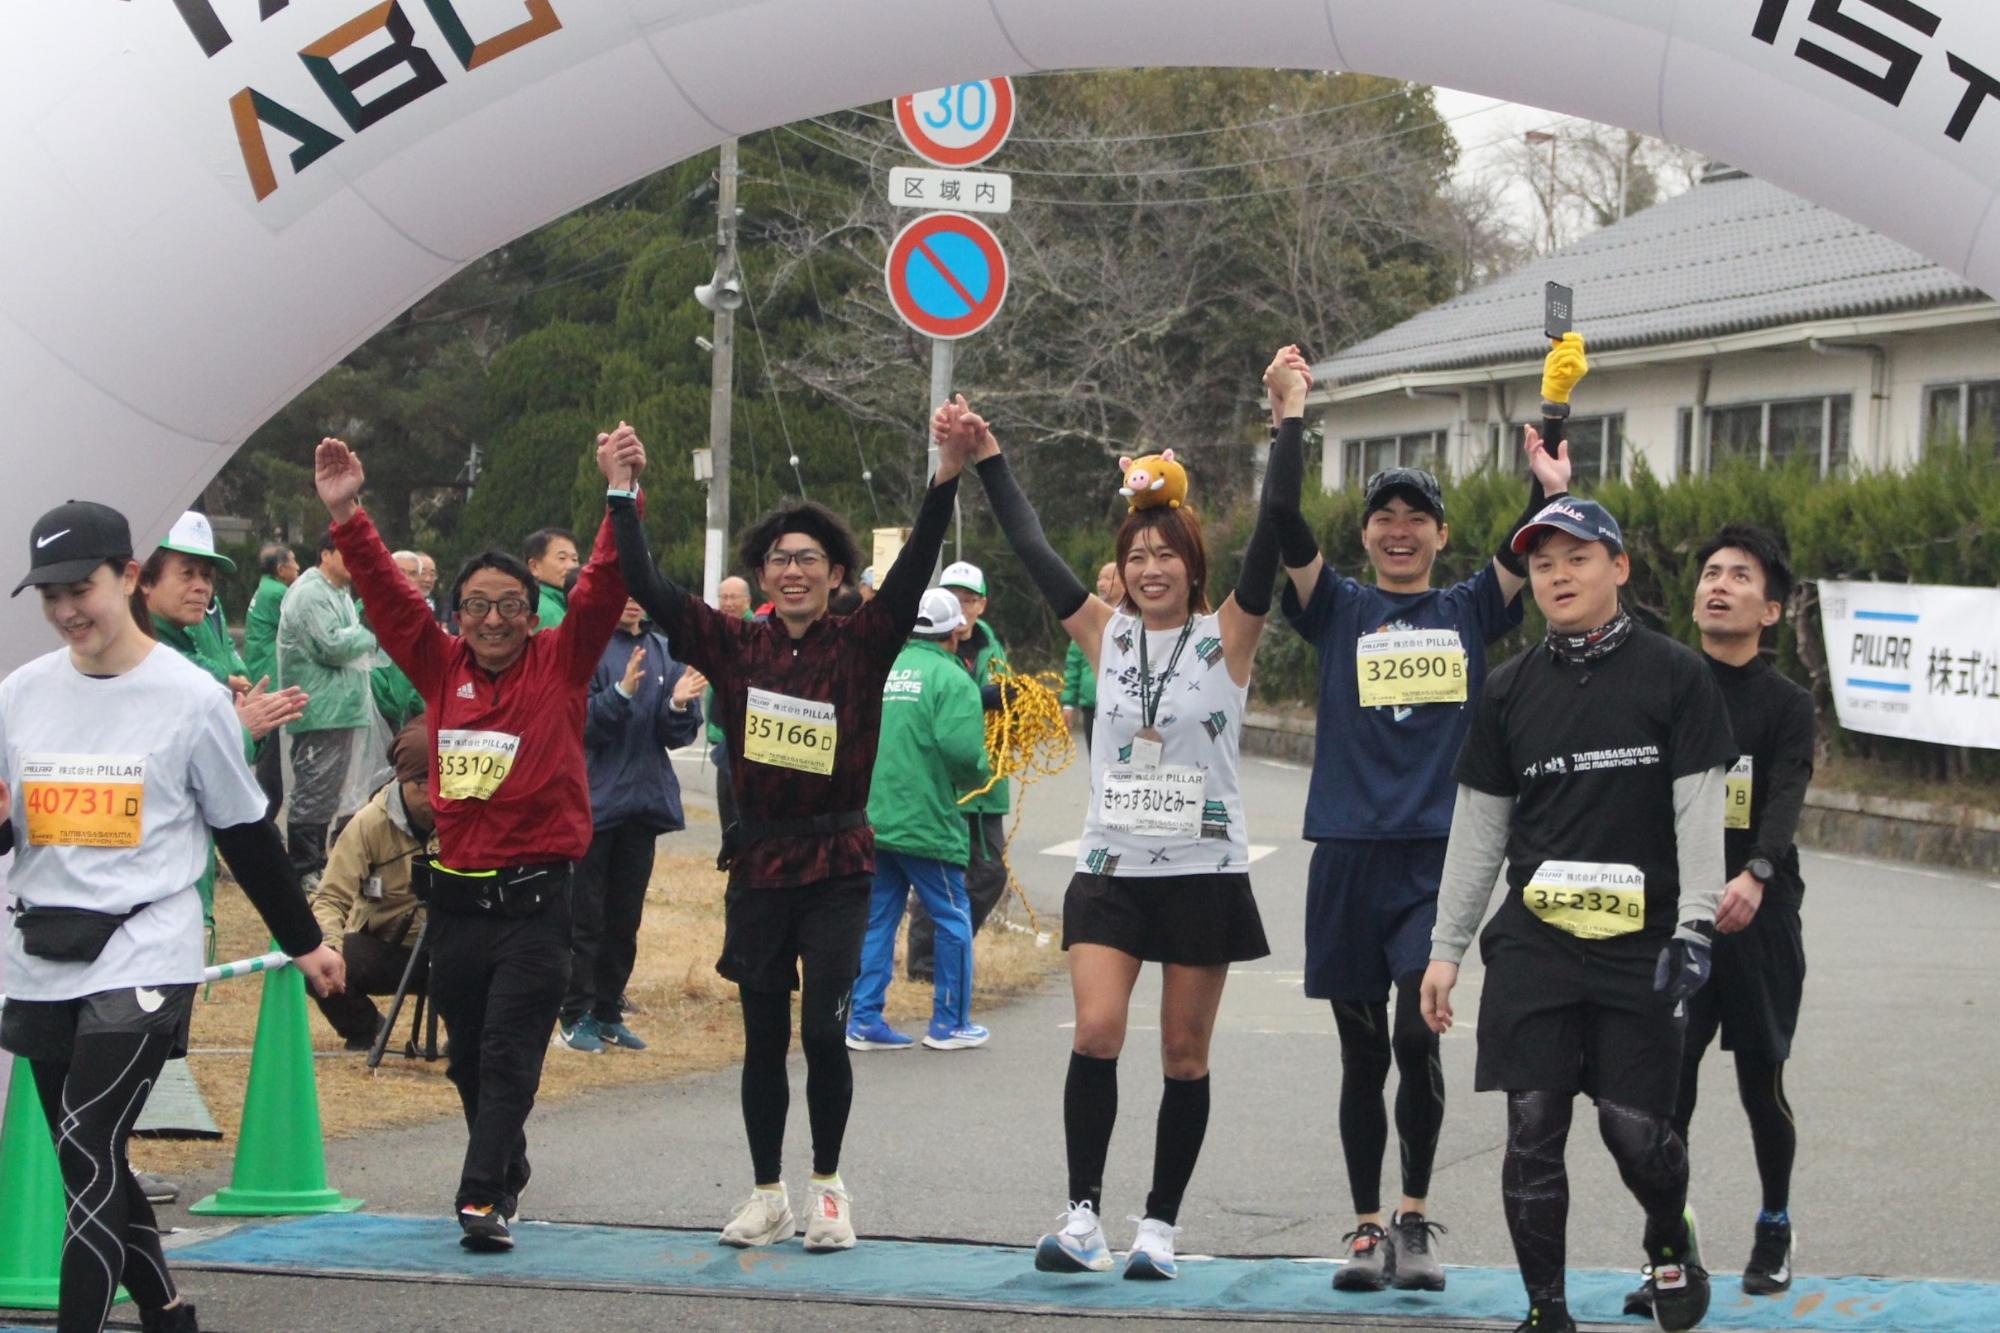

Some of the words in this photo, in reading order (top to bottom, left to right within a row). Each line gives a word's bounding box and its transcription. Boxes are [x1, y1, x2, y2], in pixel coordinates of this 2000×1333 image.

[924, 80, 987, 131] 30
[904, 176, 995, 204] 区域内
[1426, 638, 1459, 647] PILLAR
[1852, 633, 1912, 670] PILLAR
[1367, 657, 1446, 681] 32690
[1452, 663, 1462, 678] B
[748, 715, 817, 747] 35166
[821, 736, 832, 751] D
[1572, 745, 1659, 762] TAMBASASAYAMA
[1592, 757, 1637, 769] MARATHON
[58, 766, 94, 776] 株式会社
[97, 765, 142, 776] PILLAR
[493, 765, 505, 780] D
[1166, 774, 1203, 784] PILLAR
[28, 787, 114, 815] 40731
[124, 797, 138, 817] D
[1104, 787, 1197, 813] きゃっするひとみー
[1736, 790, 1746, 805] B
[1601, 873, 1643, 884] PILLAR
[1534, 890, 1622, 915] 35232
[1627, 903, 1639, 918] D
